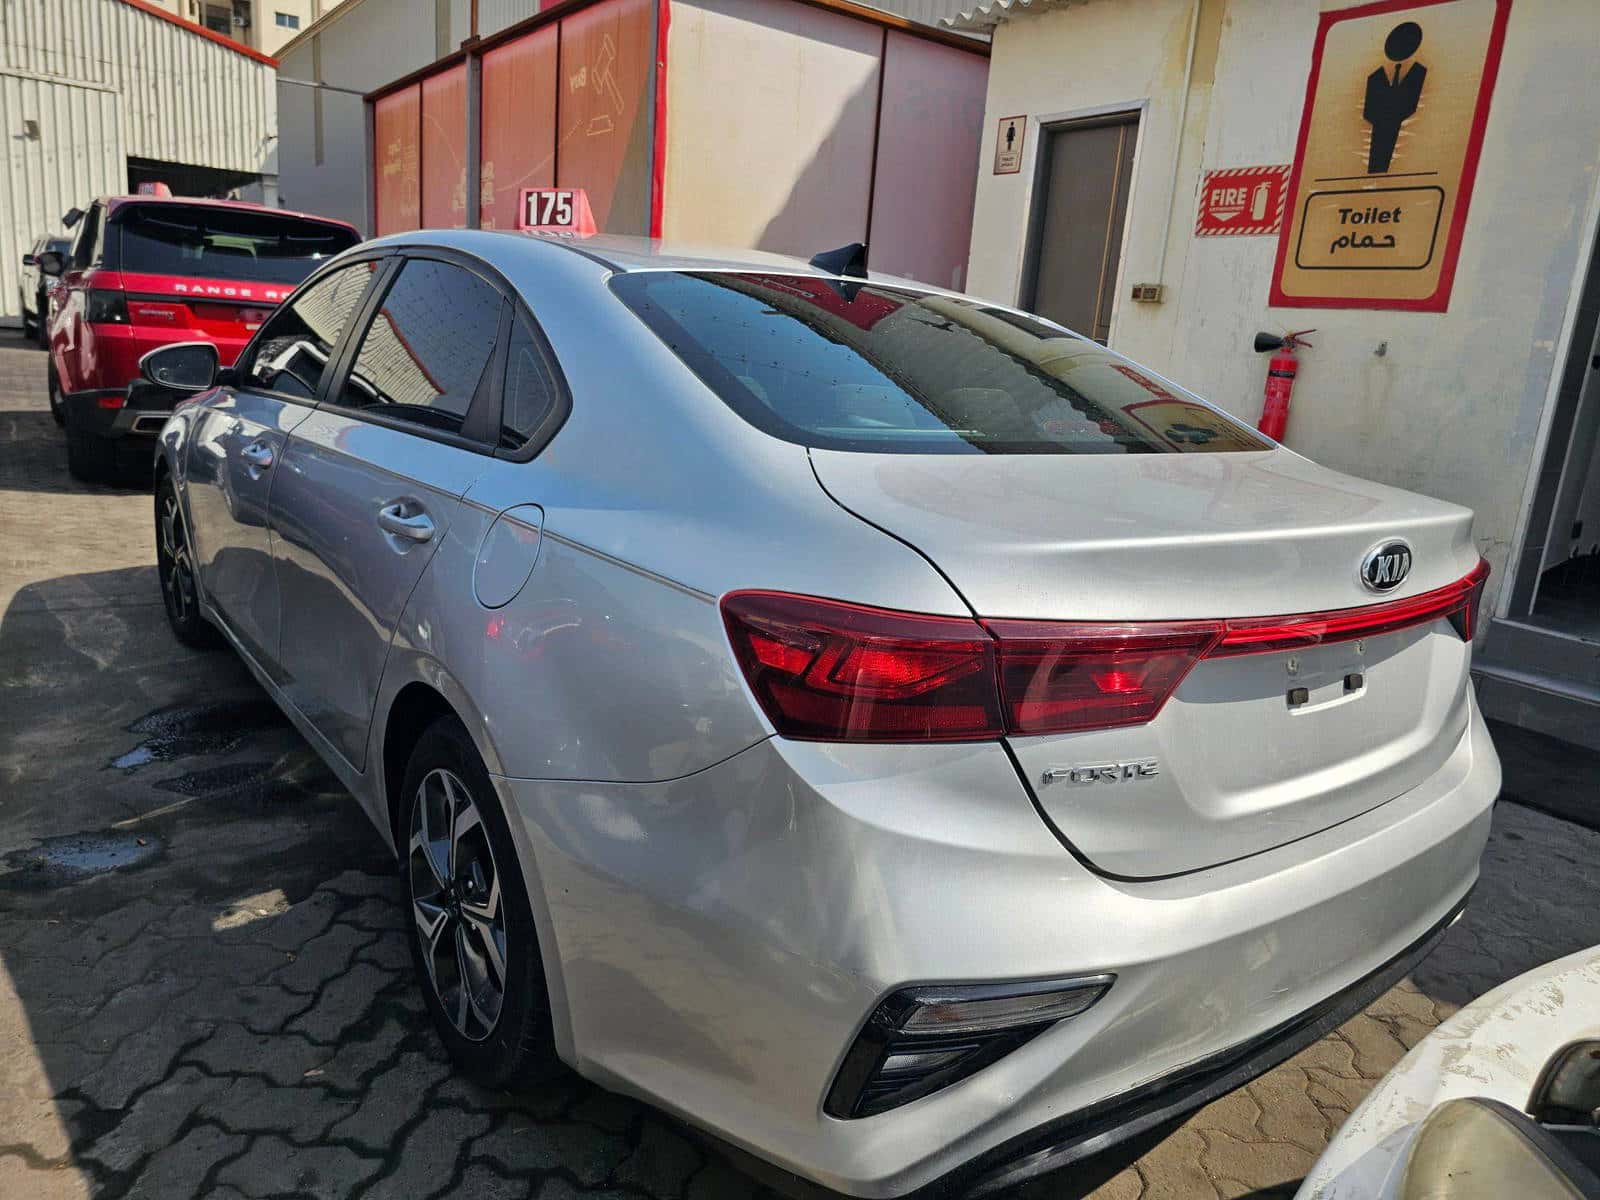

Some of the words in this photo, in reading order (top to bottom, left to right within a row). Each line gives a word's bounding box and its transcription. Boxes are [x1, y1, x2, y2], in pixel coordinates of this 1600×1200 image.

[527, 191, 572, 226] 175
[1210, 187, 1248, 207] FIRE
[1338, 207, 1402, 225] Toilet
[1330, 231, 1396, 254] حمام
[174, 283, 252, 297] RANGE
[1375, 553, 1410, 583] KIA
[1041, 760, 1160, 785] FORTE
